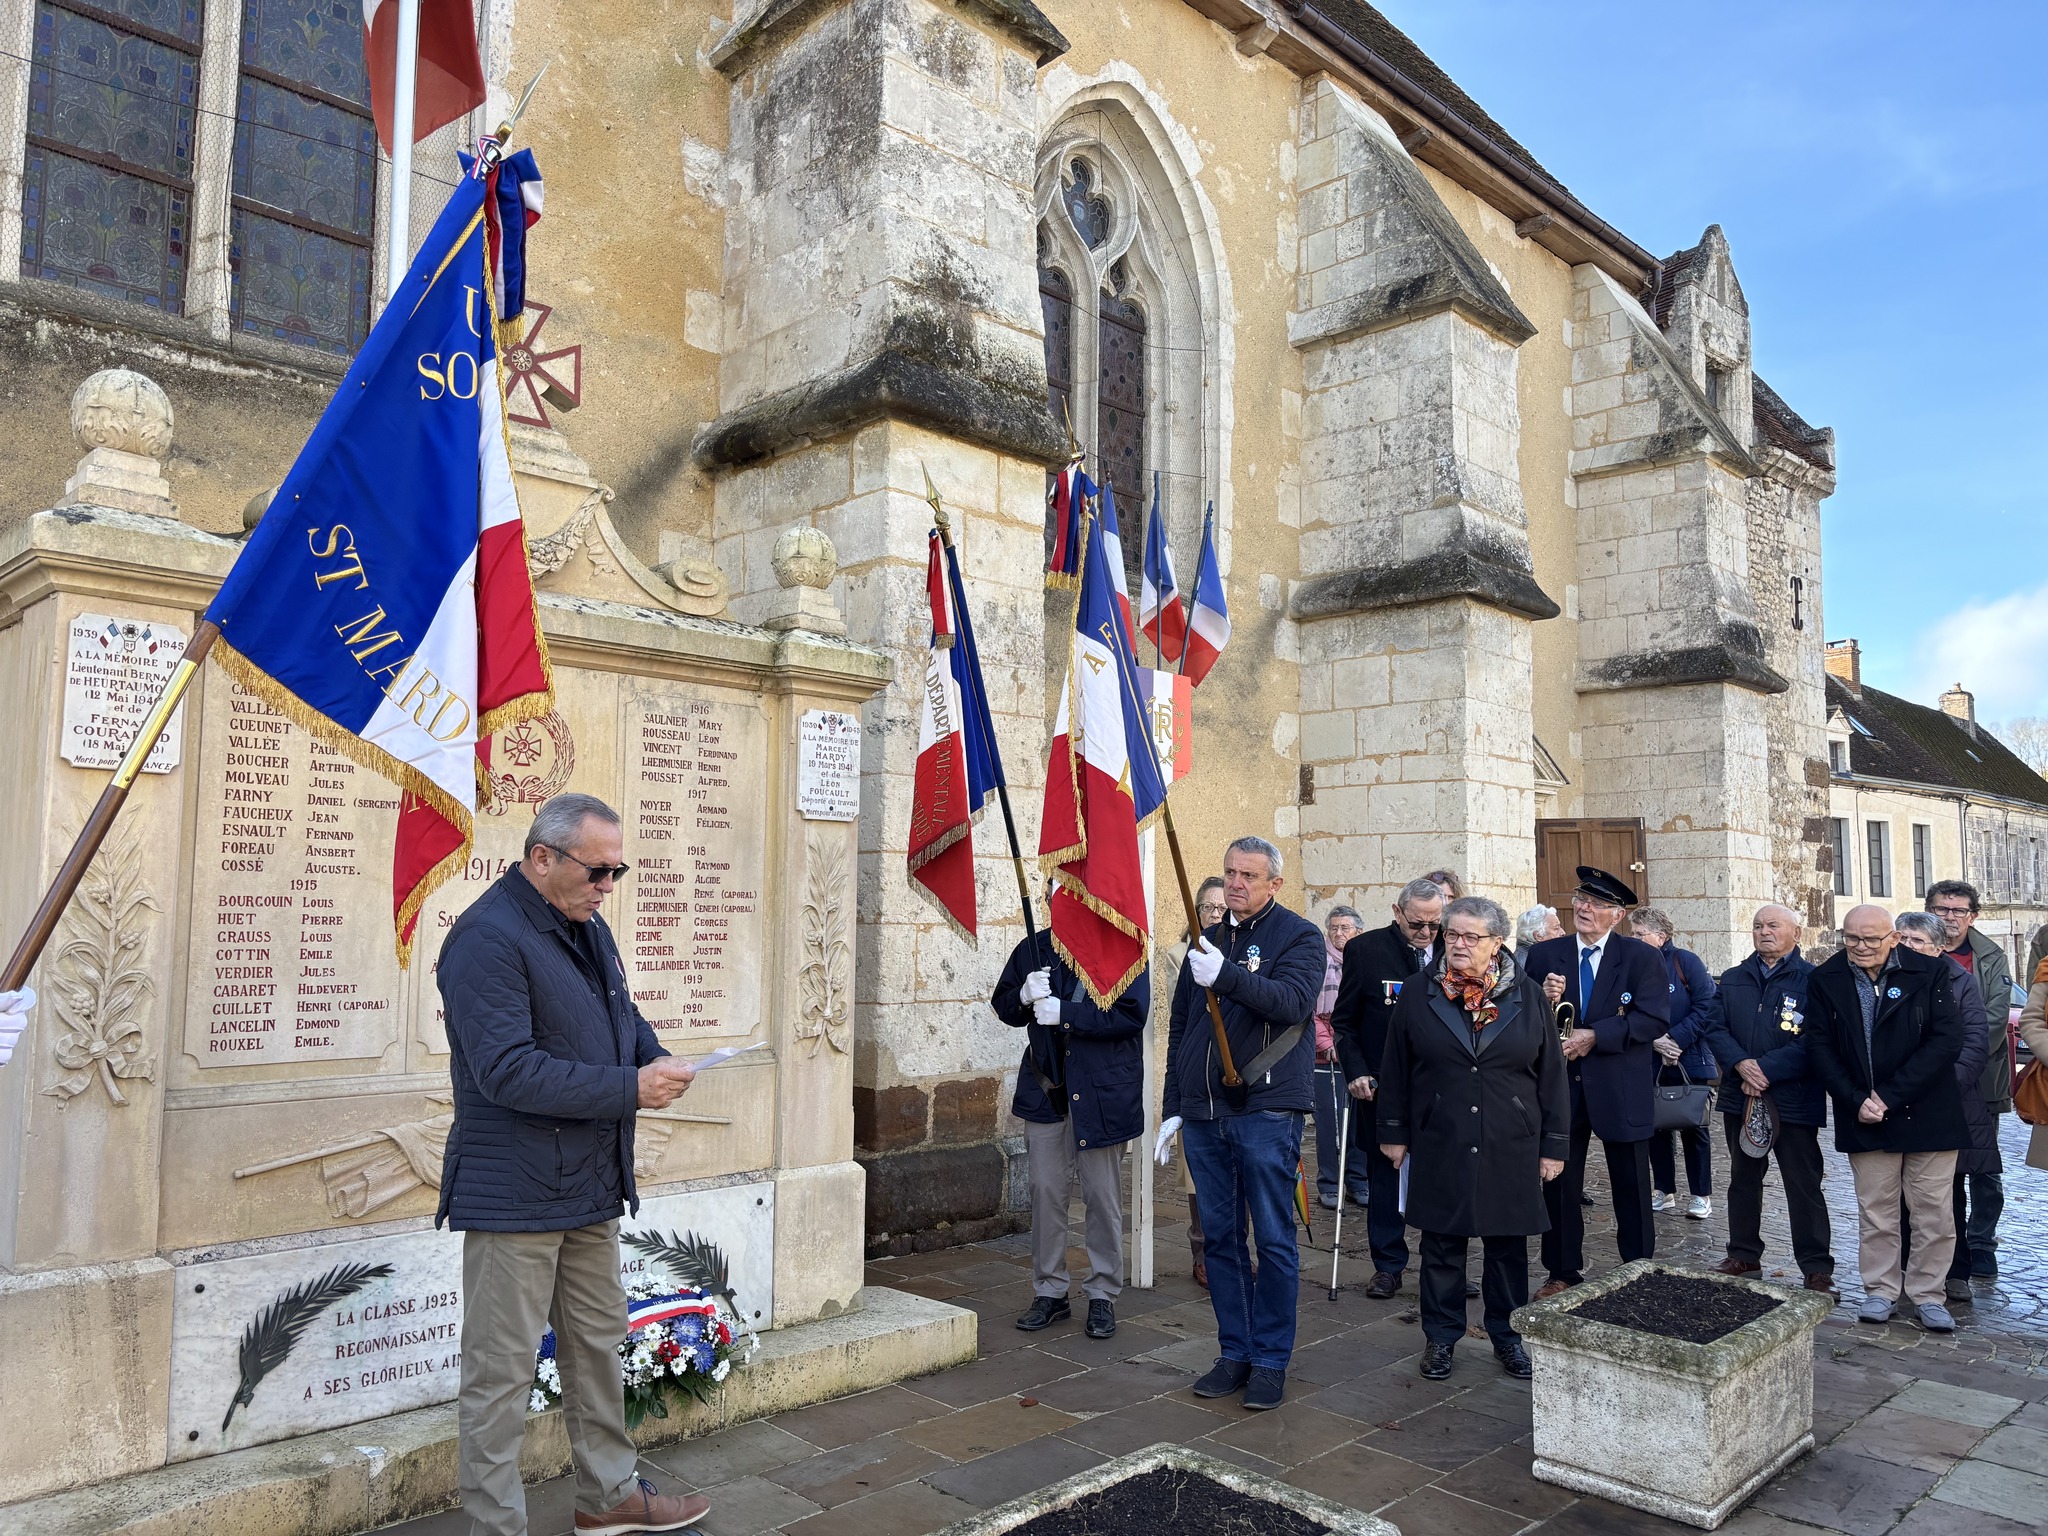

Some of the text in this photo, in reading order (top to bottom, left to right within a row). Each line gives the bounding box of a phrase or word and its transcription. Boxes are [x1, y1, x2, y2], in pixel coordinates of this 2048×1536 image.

[417, 352, 478, 400] SO
[73, 627, 98, 639] 1939
[160, 639, 185, 651] 1945
[307, 524, 470, 741] ST MARD
[75, 650, 81, 658] A
[86, 651, 100, 660] LA
[104, 651, 158, 667] MÉMOIRE
[71, 662, 171, 683] Lieutenant BERNA
[70, 677, 81, 686] DE
[85, 689, 101, 700] (12
[107, 691, 129, 703] Mai
[114, 704, 142, 714] et de
[690, 704, 709, 714] 1916
[643, 713, 723, 731] SAULNIER MARY
[642, 727, 720, 744] ROUSSEAU LÉON
[82, 739, 99, 749] (18
[104, 741, 125, 751] Mai
[228, 736, 338, 756] VALLÉE PAUL
[643, 742, 738, 760] VINCENT FERDINAND
[73, 755, 95, 764] Morts
[97, 759, 118, 767] pour
[227, 753, 355, 774] BOUCHER ARTHUR
[815, 752, 846, 762] HARDY
[641, 757, 721, 773] LHERMUSIER HENRI
[838, 763, 853, 771] 1941
[225, 771, 344, 790] MOLVEAU JULES
[641, 771, 684, 784] POUSSET
[224, 789, 273, 802] FARNY
[307, 794, 346, 807] DANIEL
[688, 789, 707, 800] 1917
[810, 788, 849, 798] FOUCAULT
[640, 800, 728, 815] NOYER ARMAND
[223, 806, 339, 823] FAUCHEUX JEAN
[640, 815, 680, 826] POUSSET
[222, 824, 354, 841] ESNAULT FERNAND
[221, 842, 356, 858] FOREAU ANSBERT
[687, 846, 706, 856] 1918
[221, 857, 264, 872] COSSÉ
[638, 858, 730, 871] MILLET RAYMOND
[290, 879, 318, 891] 1915
[695, 875, 721, 885] ALCIDE
[637, 887, 676, 898] DOLLION
[721, 890, 758, 900] (CAPORAL)
[302, 897, 334, 908] LOUIS
[637, 902, 688, 913] LHERMUSIER
[217, 913, 343, 925] HUET PIERRE
[300, 931, 332, 943] LOUIS
[636, 931, 728, 942] REINE ANATOLE
[216, 948, 332, 961] COTTIN EMILE
[693, 946, 722, 956] JUSTIN
[215, 966, 336, 979] VERDIER JULES
[635, 960, 690, 972] TAILLANDIER
[683, 974, 703, 984] 1919
[213, 983, 358, 997] CABARET HILDEVERT
[633, 990, 668, 1001] NAVEAU
[212, 998, 390, 1015] GUILLET HENRI (CAPORAL)
[682, 1003, 703, 1014] 1920
[210, 1019, 340, 1034] LANCELIN EDMOND
[209, 1038, 264, 1052] ROUXEL
[336, 1291, 458, 1327] LA CLASSE 1923
[336, 1323, 456, 1359] RECONNAISSANTE
[303, 1386, 312, 1400] A
[324, 1377, 351, 1395] SES
[361, 1359, 433, 1388] GLORIEUX
